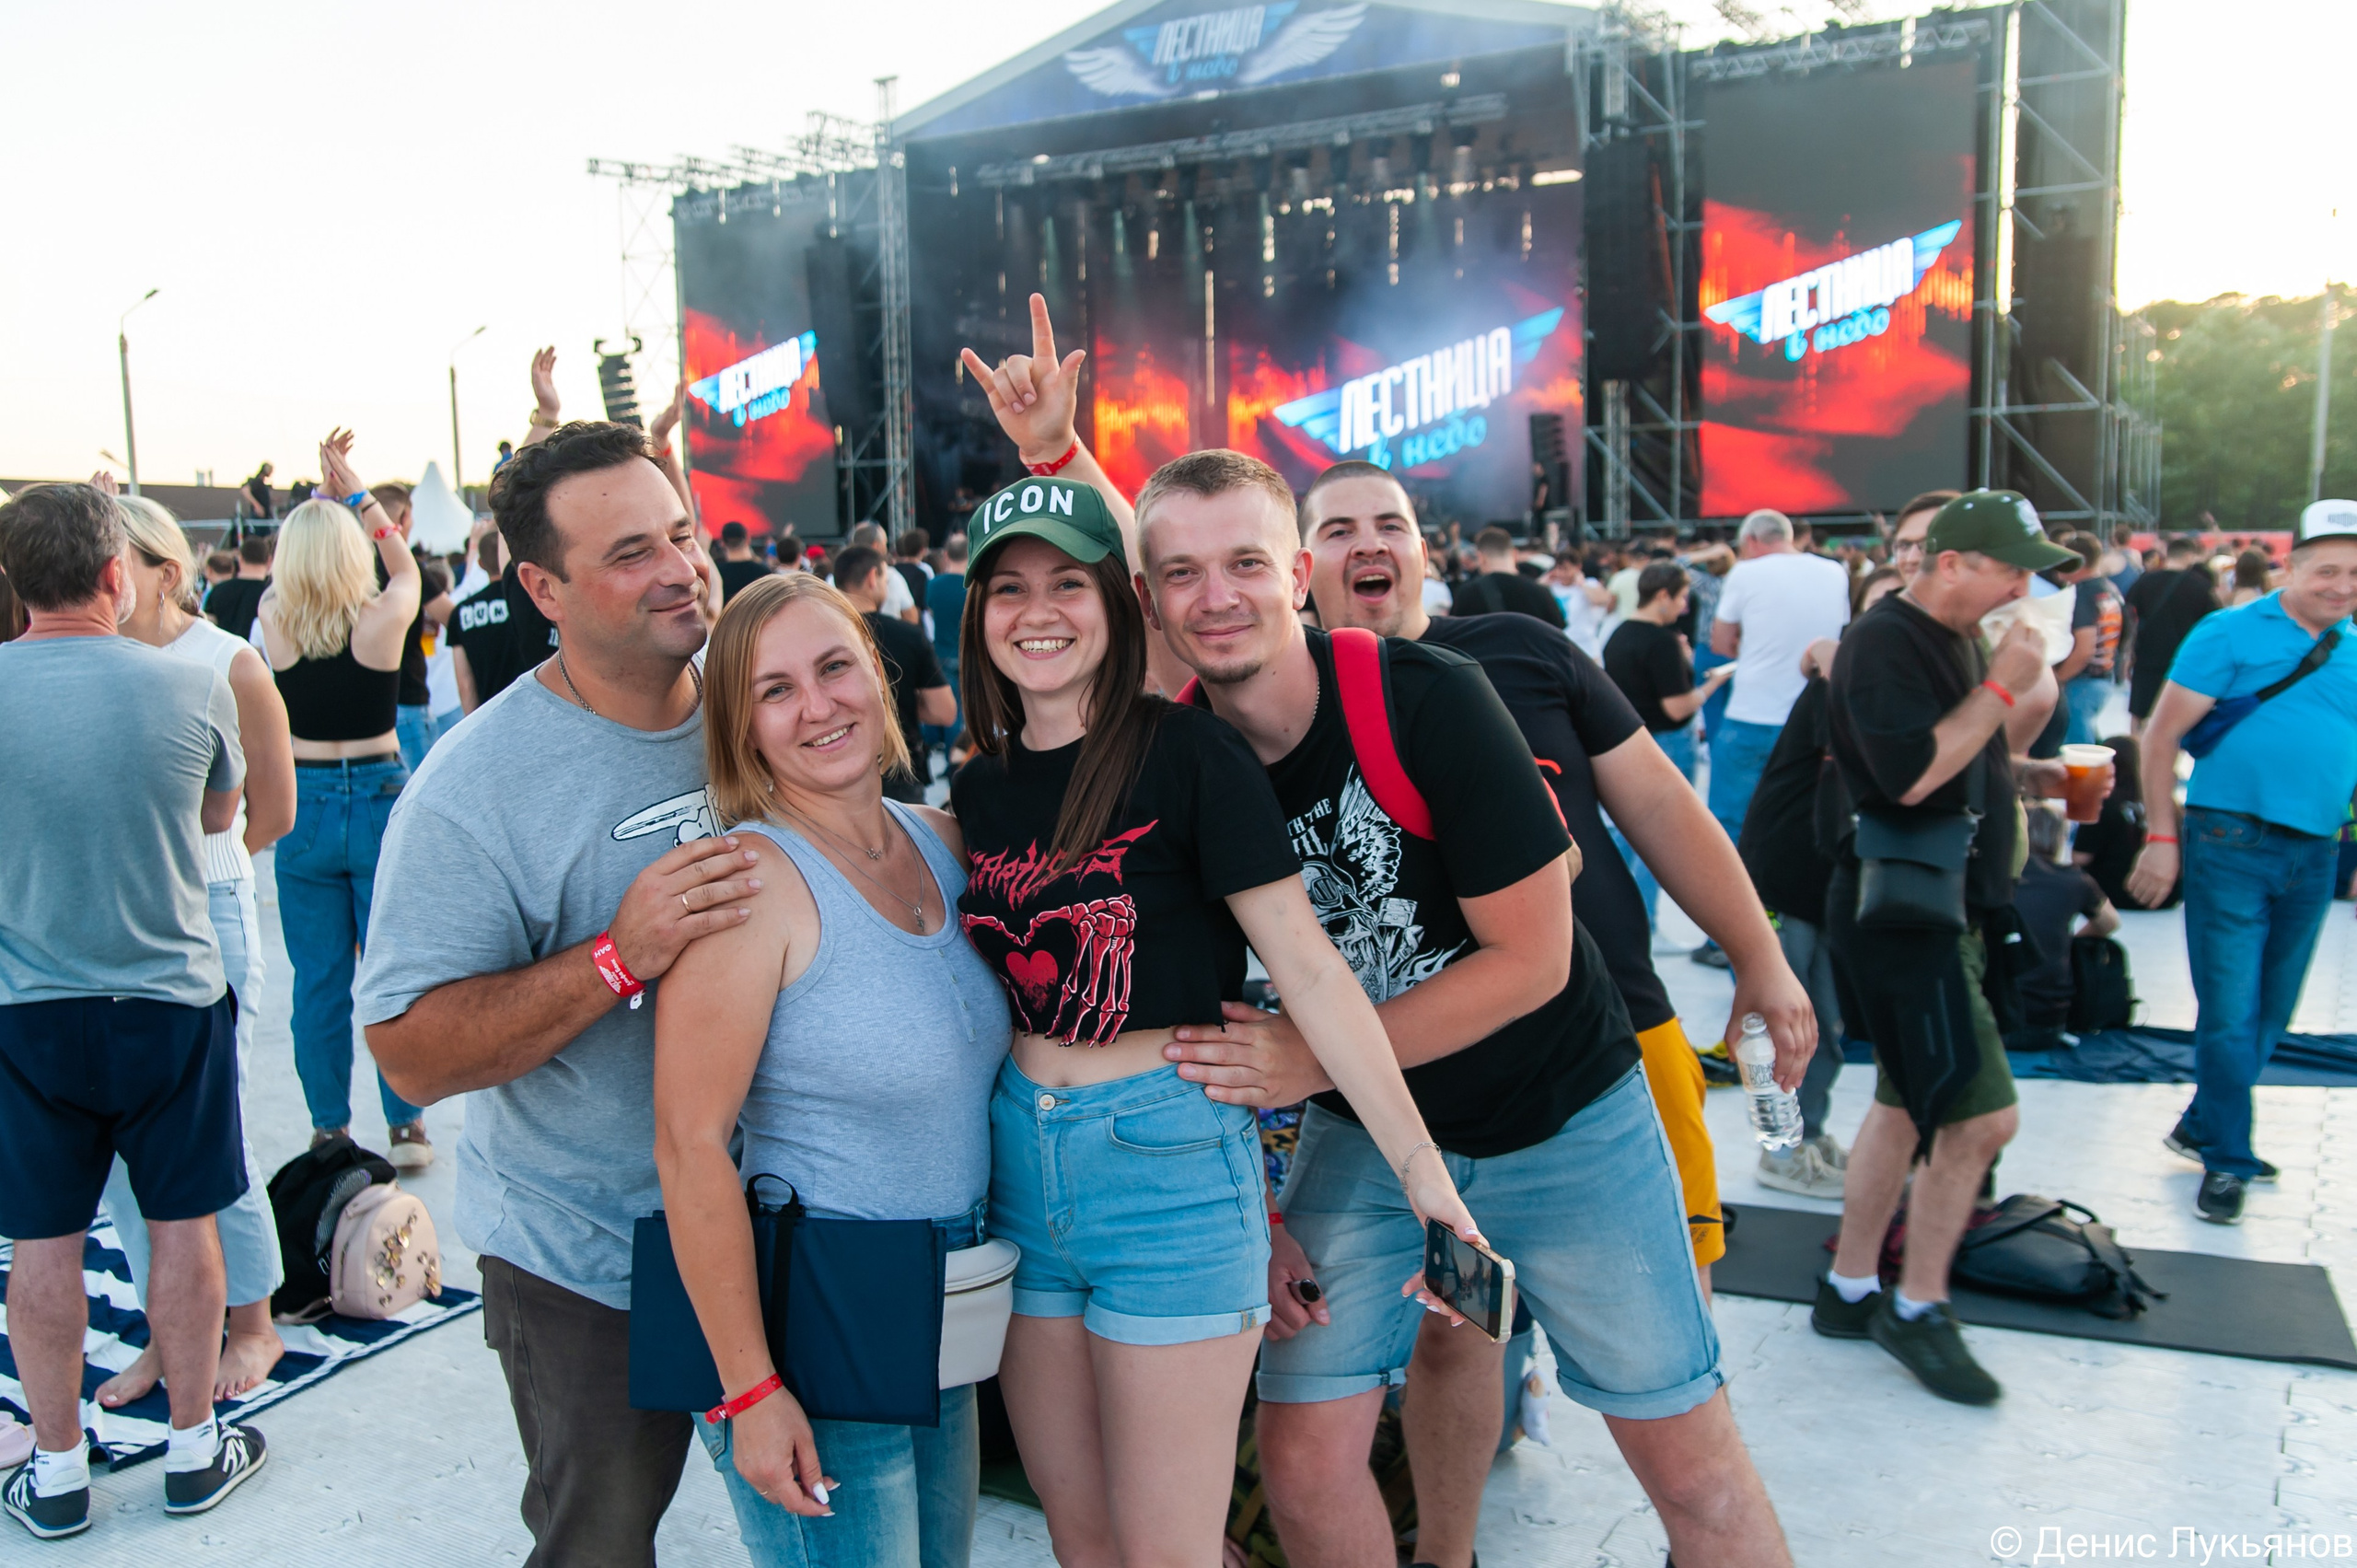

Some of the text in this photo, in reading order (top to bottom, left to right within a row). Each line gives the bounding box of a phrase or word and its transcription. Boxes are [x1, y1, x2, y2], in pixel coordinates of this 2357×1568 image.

[1153, 4, 1266, 65] ЛЕСТНИЦА
[1339, 326, 1512, 454] ЛЕСТНИЦА
[983, 485, 1074, 534] ICON
[459, 599, 509, 632] LUM
[1305, 798, 1332, 823] THE
